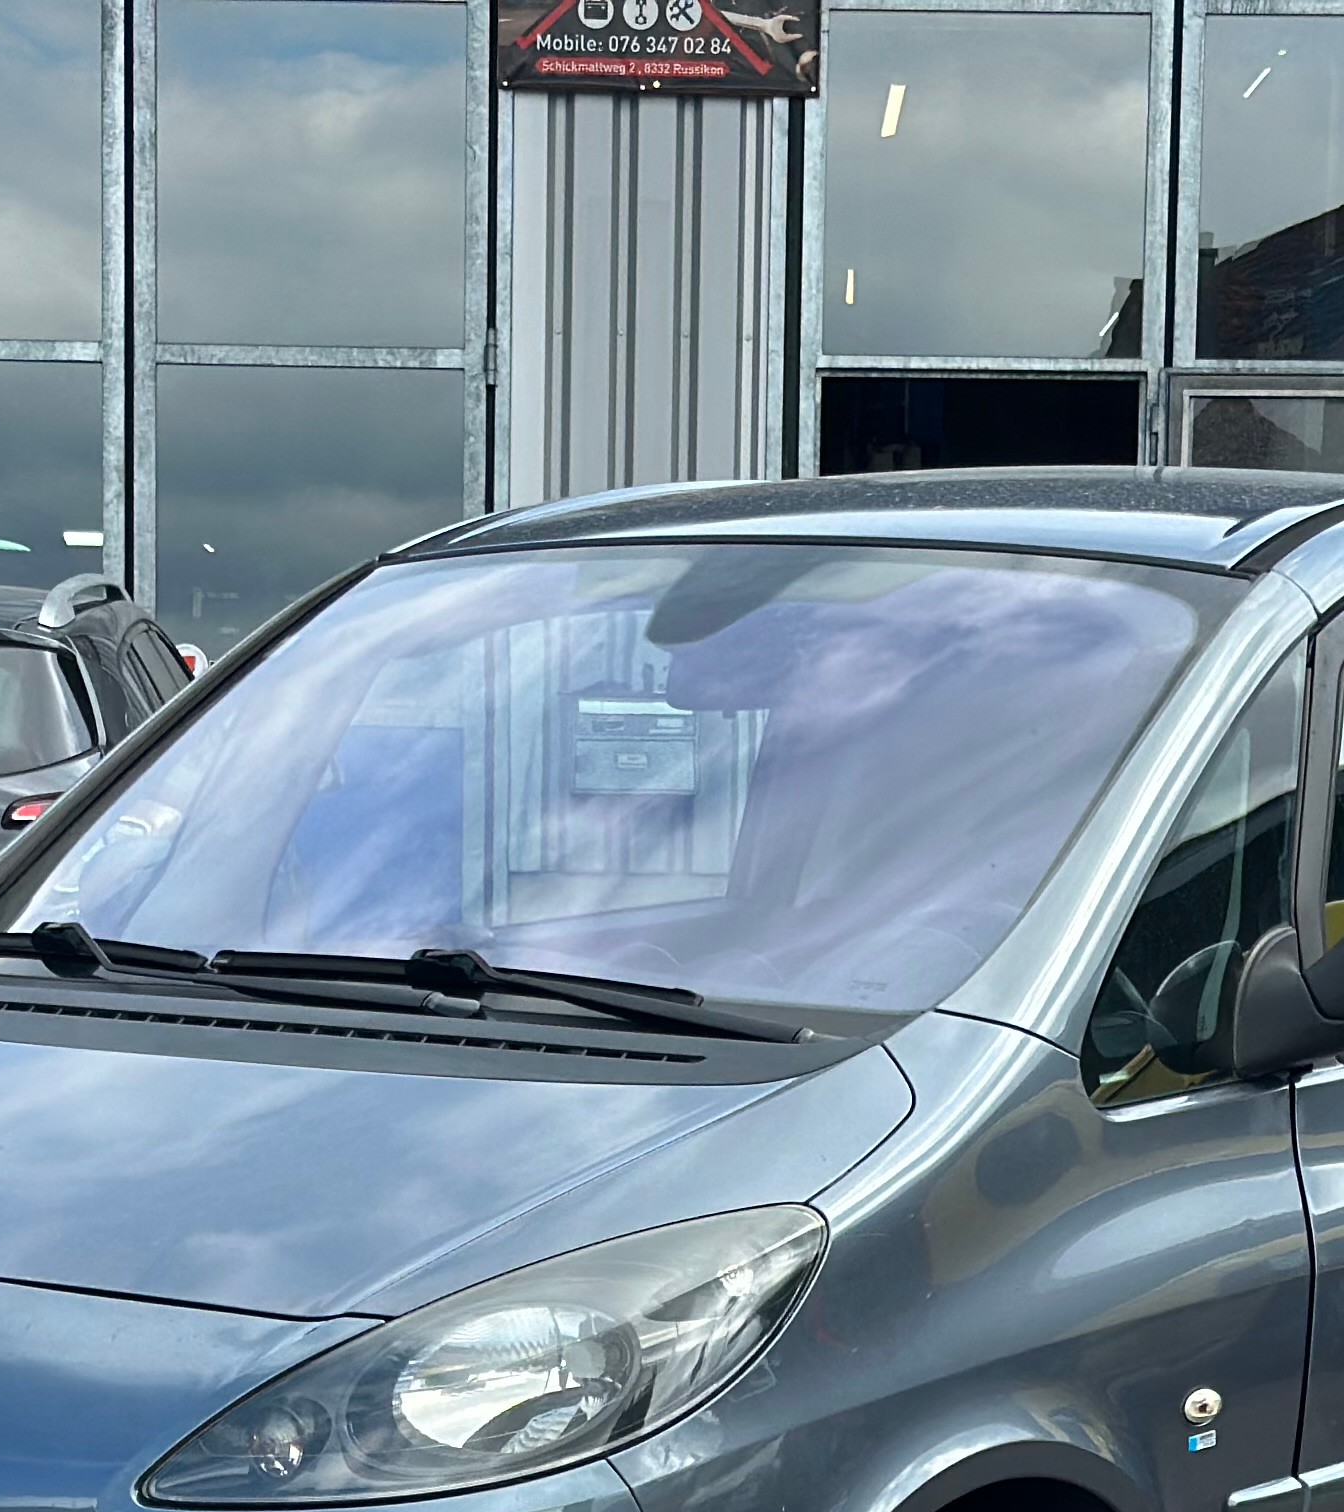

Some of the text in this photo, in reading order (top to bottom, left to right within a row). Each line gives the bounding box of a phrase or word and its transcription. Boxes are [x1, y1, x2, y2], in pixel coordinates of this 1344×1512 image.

[536, 34, 732, 55] Mobile: 076 347 02 84
[644, 63, 670, 74] 8332
[673, 63, 724, 75] Russikon
